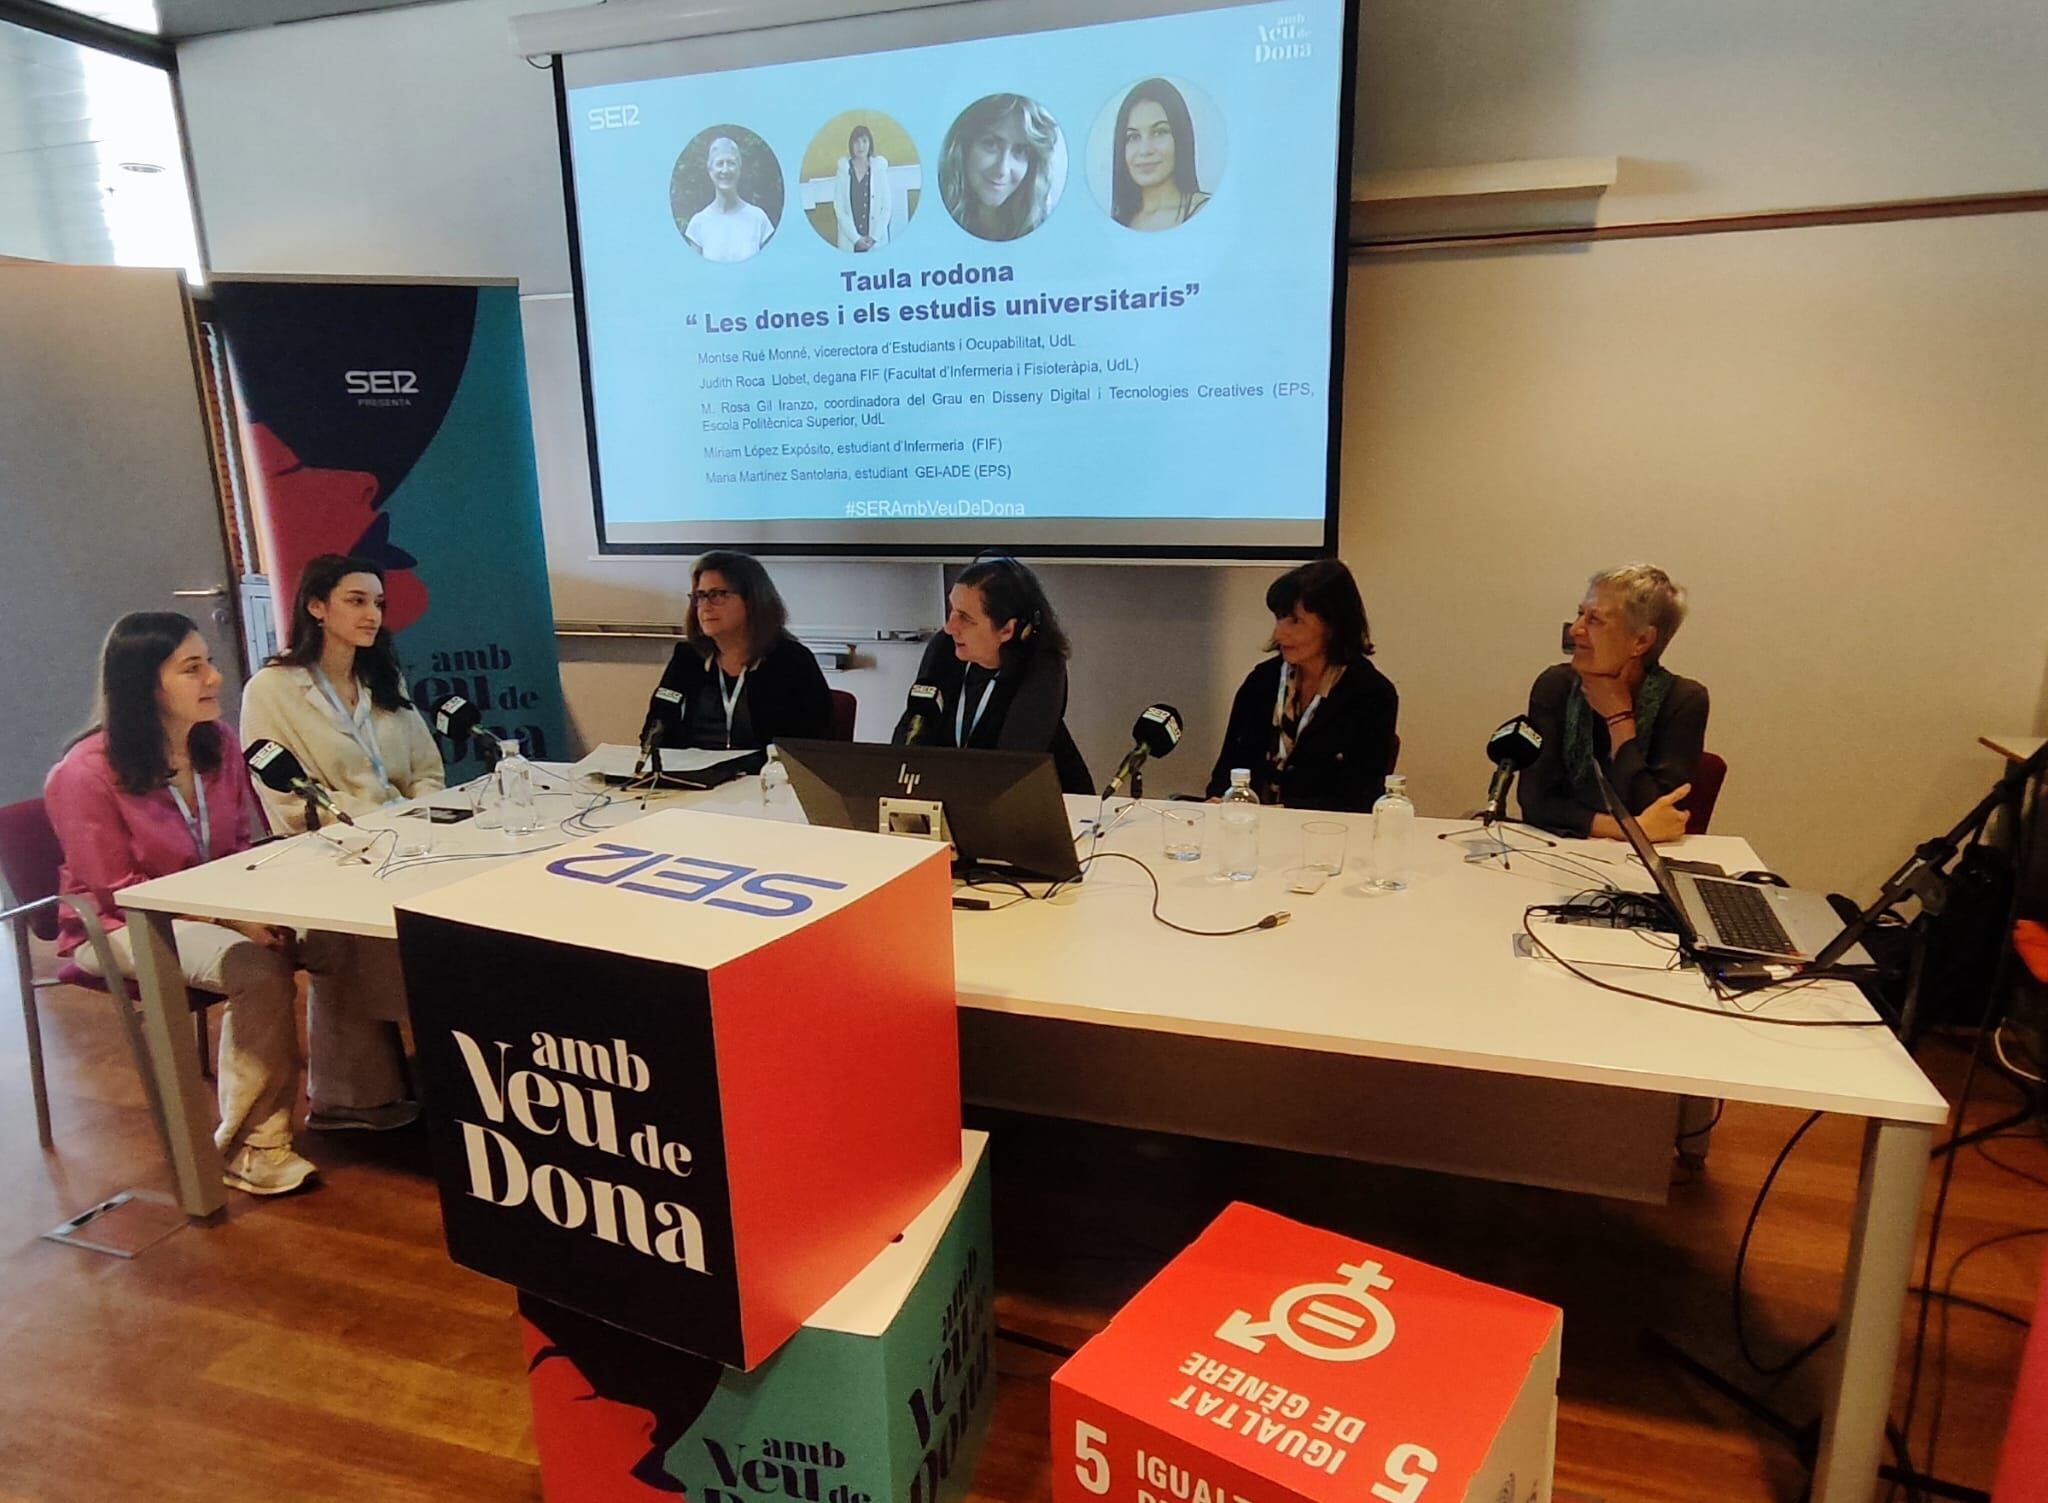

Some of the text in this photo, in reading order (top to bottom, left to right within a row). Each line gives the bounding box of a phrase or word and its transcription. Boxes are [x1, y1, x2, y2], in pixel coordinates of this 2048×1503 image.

[588, 104, 640, 130] SER
[840, 262, 1014, 292] Taula rodona
[705, 312, 748, 333] Les
[755, 309, 830, 330] dones
[838, 304, 845, 325] i
[853, 302, 890, 324] els
[899, 296, 997, 322] estudis
[698, 350, 739, 365] Montse
[742, 349, 766, 362] Rué
[769, 346, 811, 361] Monné,
[814, 343, 878, 358] vicerectora
[965, 334, 1046, 353] Ocupabilitat,
[1049, 334, 1077, 348] UdL
[344, 370, 419, 394] SER
[699, 376, 733, 390] Judith
[736, 375, 766, 388] Roca
[771, 372, 811, 388] Llobet,
[813, 371, 857, 386] degana
[860, 369, 880, 382] FIF
[883, 366, 936, 382] (Facultat
[1024, 359, 1103, 377] Fisioteràpia,
[1106, 358, 1140, 374] UdL)
[721, 400, 751, 413] Rosa
[756, 399, 773, 412] Gil
[778, 399, 818, 413] Iranzo,
[823, 393, 901, 410] coordinadora
[906, 392, 926, 407] del
[932, 392, 962, 406] Grau
[969, 393, 986, 404] en
[992, 390, 1044, 405] Disseny
[1050, 387, 1091, 404] Digital
[1109, 384, 1190, 401] Tecnologies
[1197, 383, 1264, 398] Creatives
[1272, 382, 1315, 399] (EPS,
[702, 413, 885, 432] Escola Politècnica Superior, UdL
[704, 445, 742, 459] Miriam
[744, 442, 779, 460] López
[781, 441, 834, 460] Expósito,
[836, 440, 891, 455] estudiant
[971, 437, 1003, 453] (FIF)
[705, 470, 737, 484] Maria
[739, 467, 788, 483] Martínez
[854, 466, 908, 480] estudiant
[914, 464, 971, 479] GEI-ADE
[973, 463, 1012, 480] (EPS)
[845, 499, 1026, 518] #SERAmbVeuDeDona
[432, 643, 512, 673] amb
[404, 664, 539, 713] eu de
[545, 842, 848, 917] SER
[531, 1031, 650, 1093] amb
[452, 1029, 693, 1177] Veu de
[455, 1119, 712, 1276] Dona
[1178, 1352, 1367, 1444] DE GÈNERE
[1169, 1384, 1347, 1475] IGUALTAT
[762, 1437, 846, 1469] amb
[1075, 1418, 1111, 1495] 5
[701, 1436, 820, 1503] Veu
